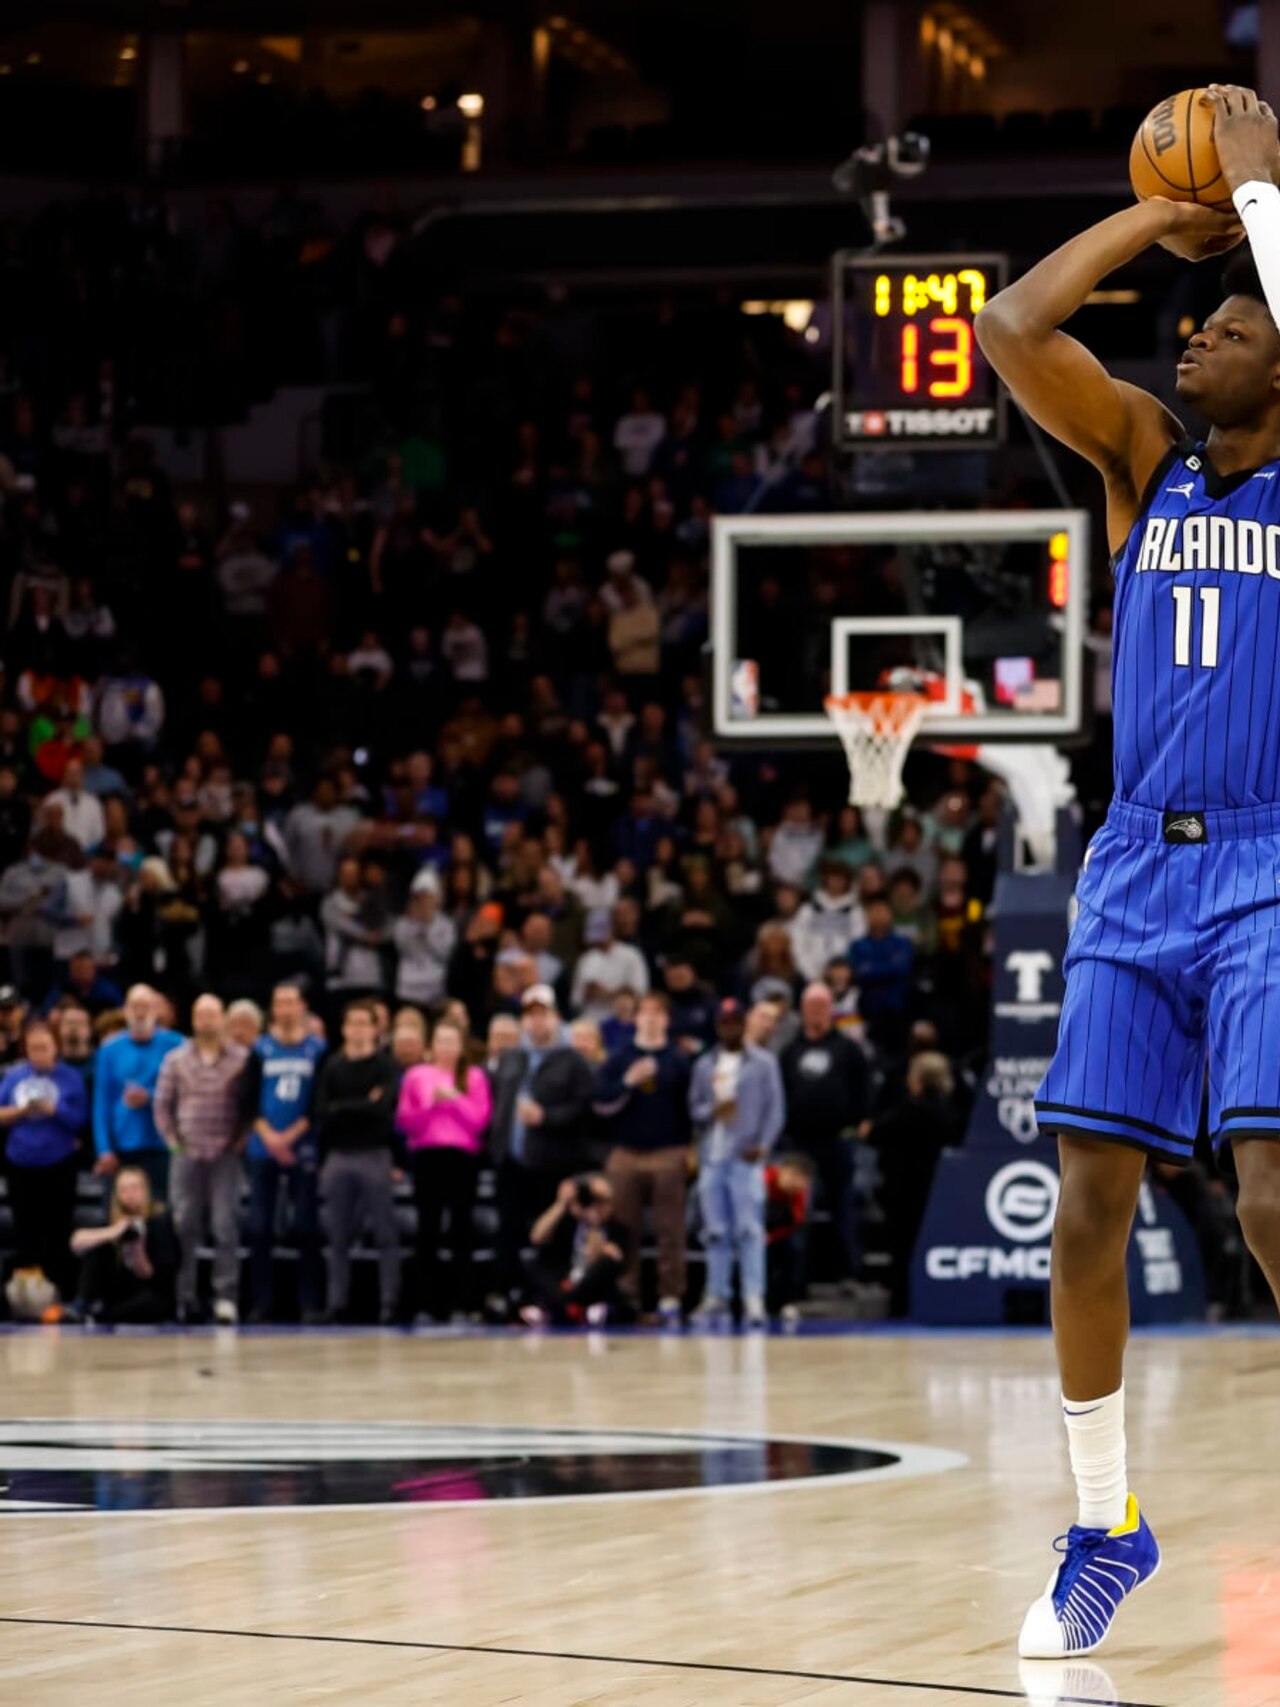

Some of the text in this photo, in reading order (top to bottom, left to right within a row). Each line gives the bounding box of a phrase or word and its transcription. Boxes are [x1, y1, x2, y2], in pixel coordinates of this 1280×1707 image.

[875, 269, 986, 317] 11:47
[902, 318, 972, 398] 13
[887, 408, 993, 434] TISSOT
[1172, 585, 1220, 668] 11
[926, 1246, 1051, 1279] CFMO
